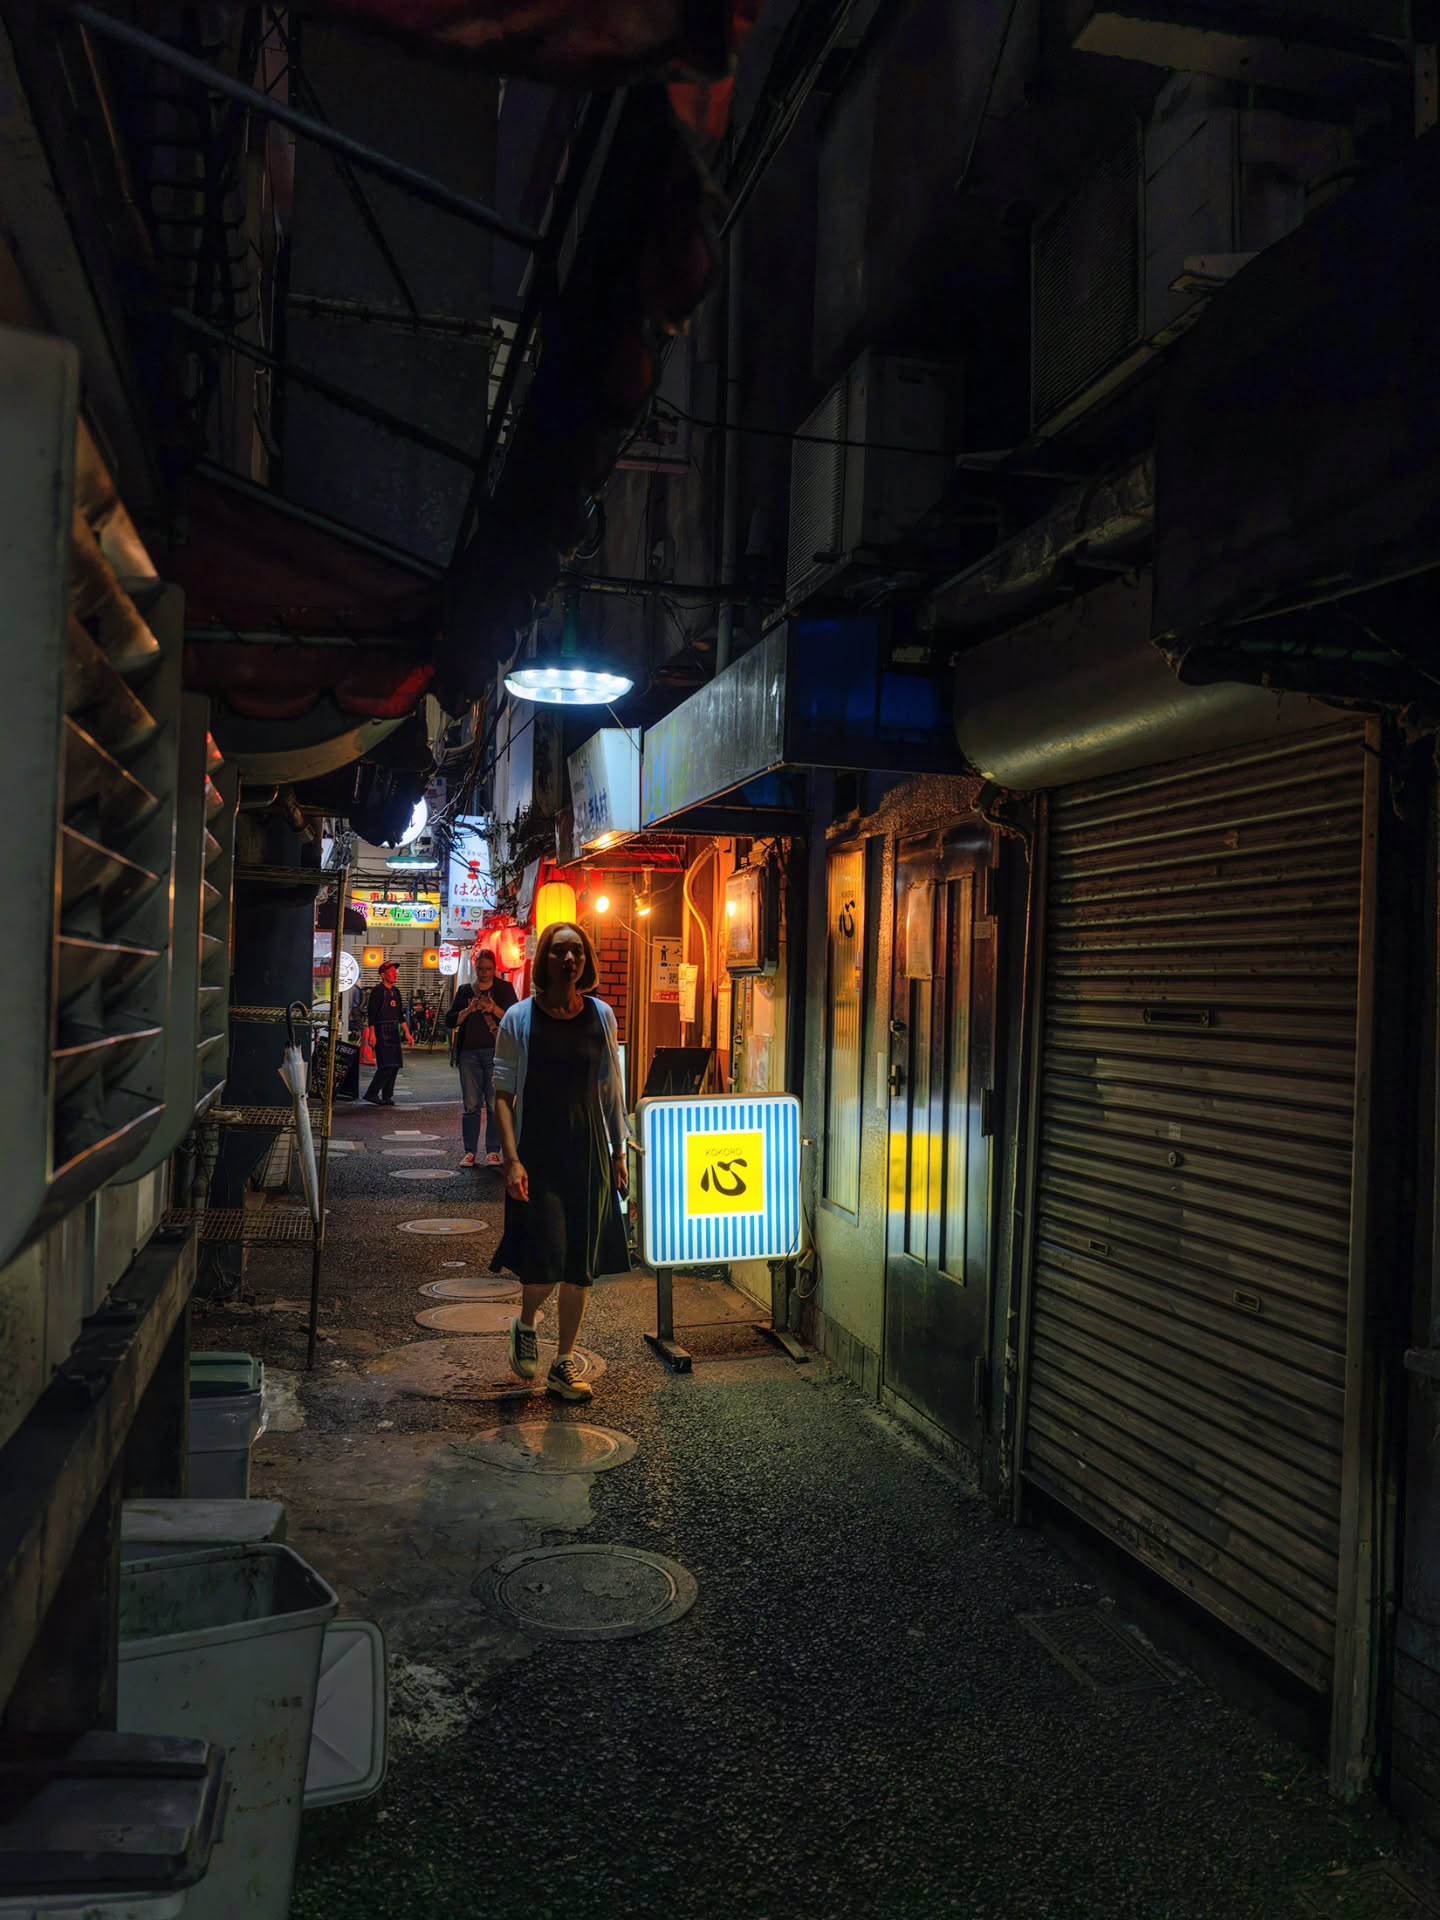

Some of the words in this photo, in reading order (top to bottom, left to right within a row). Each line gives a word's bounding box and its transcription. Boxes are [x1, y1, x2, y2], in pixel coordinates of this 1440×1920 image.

[454, 882, 495, 898] はなれ
[700, 1157, 748, 1197] 心
